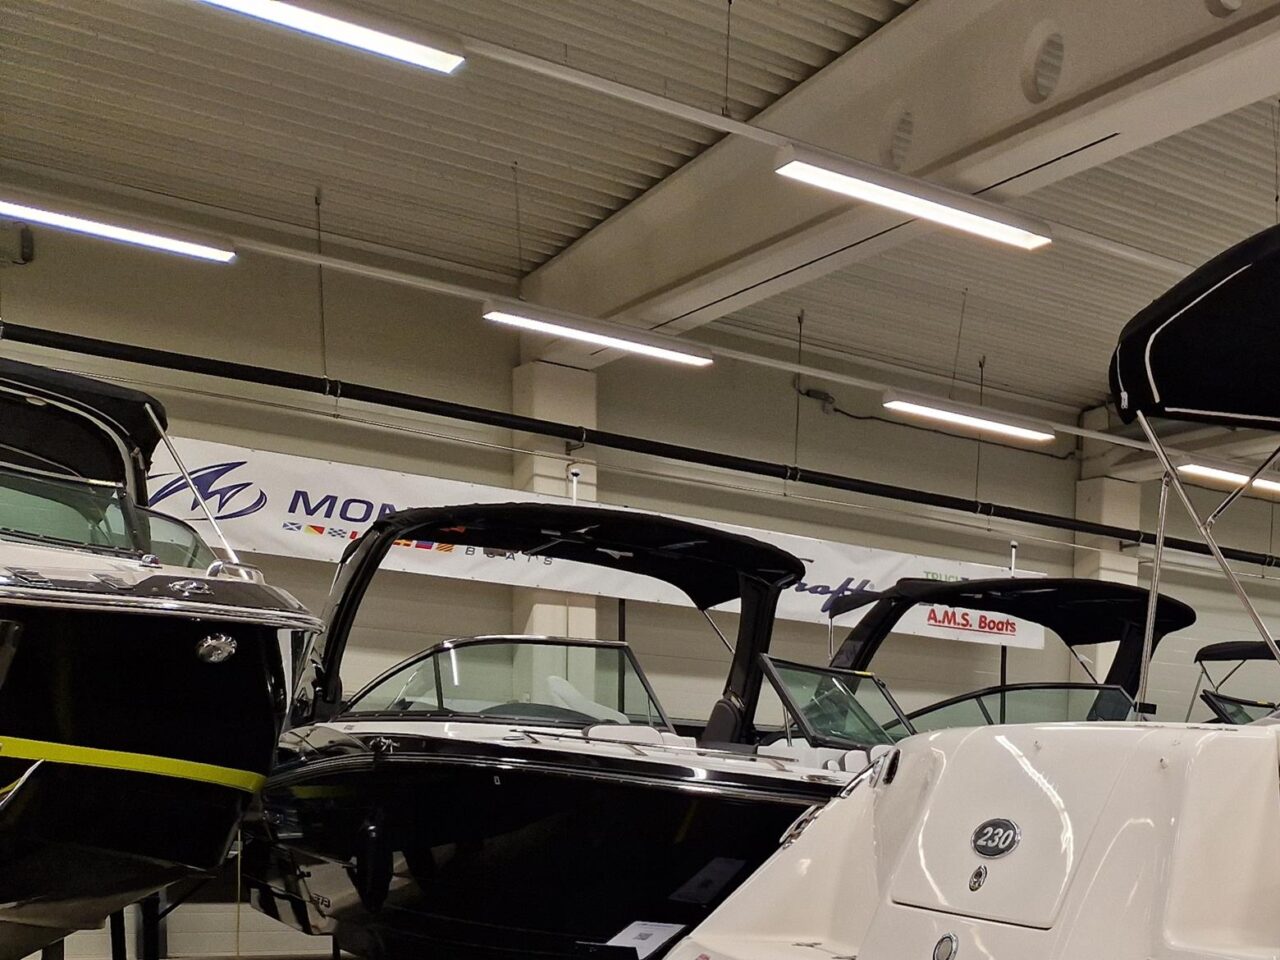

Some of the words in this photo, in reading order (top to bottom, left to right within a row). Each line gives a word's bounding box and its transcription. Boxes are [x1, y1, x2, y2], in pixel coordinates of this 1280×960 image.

[927, 608, 973, 627] A.M.S.
[978, 615, 1016, 633] Boats
[976, 826, 1014, 849] 230
